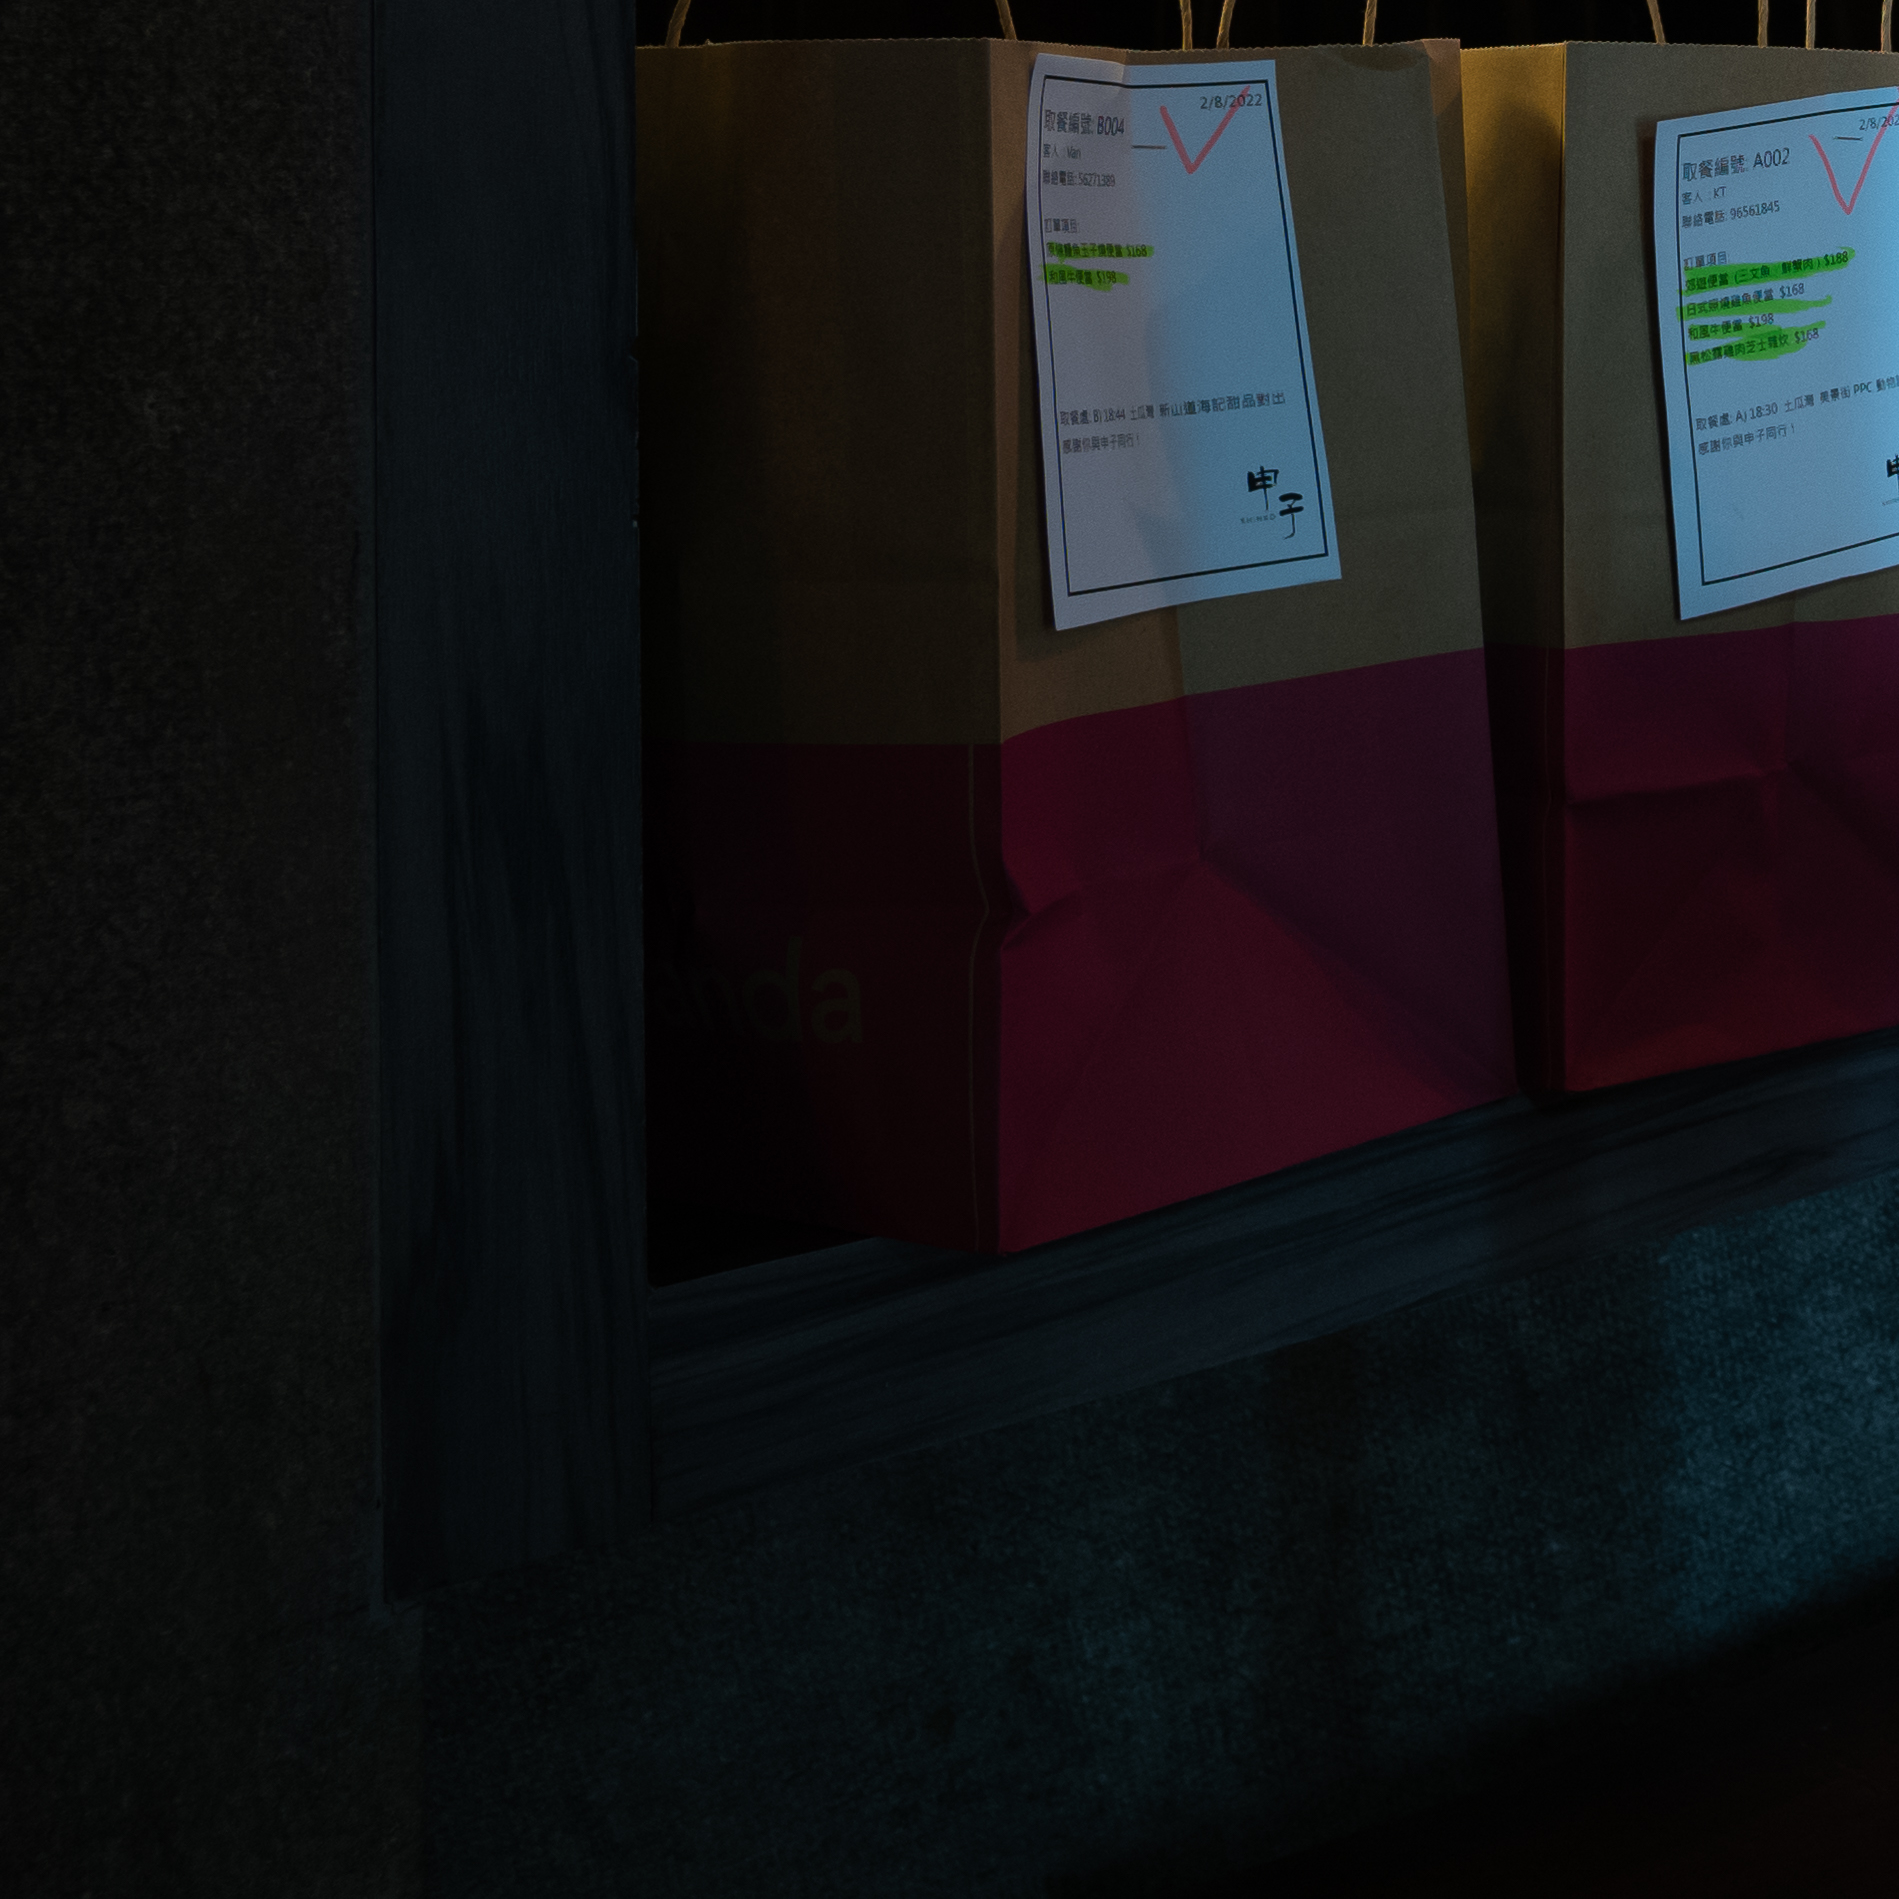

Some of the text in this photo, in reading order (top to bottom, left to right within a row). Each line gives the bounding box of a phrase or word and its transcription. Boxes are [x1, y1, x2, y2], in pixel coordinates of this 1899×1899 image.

[1200, 93, 1263, 110] 2/8/2022
[1097, 115, 1125, 136] B004
[1753, 147, 1790, 170] A002
[1713, 186, 1727, 200] KT
[1730, 200, 1781, 221] 96561845
[1823, 251, 1849, 267] $188
[1779, 283, 1805, 299] $168
[1748, 313, 1774, 329] $198
[1794, 327, 1820, 344] $168
[1749, 402, 1779, 420] 18:30
[1853, 381, 1872, 394] PPC
[1247, 465, 1304, 540] 申子
